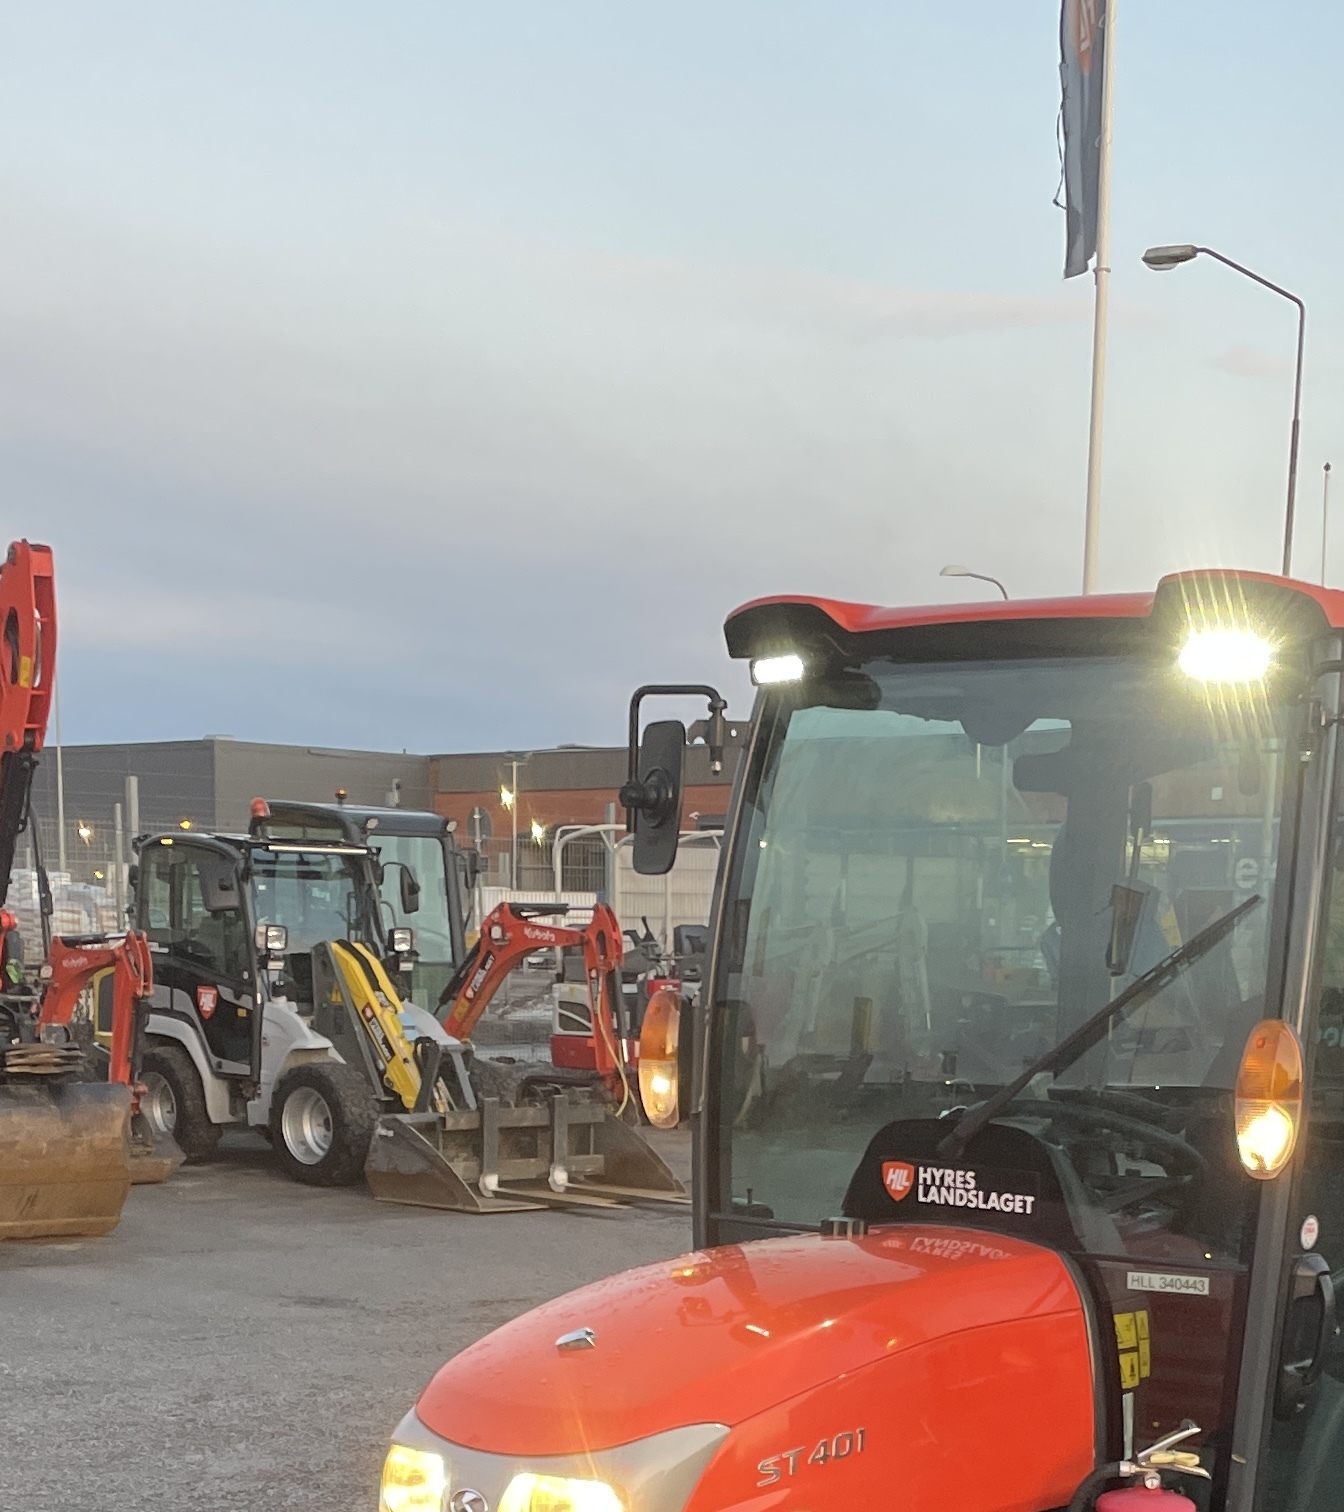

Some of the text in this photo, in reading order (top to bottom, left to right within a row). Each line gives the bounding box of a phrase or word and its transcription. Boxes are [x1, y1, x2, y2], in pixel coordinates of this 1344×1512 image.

[523, 926, 556, 942] Kubota
[918, 1166, 977, 1190] HYRES
[917, 1184, 1036, 1215] LANDSLAGET
[1130, 1273, 1206, 1292] HLL 340443
